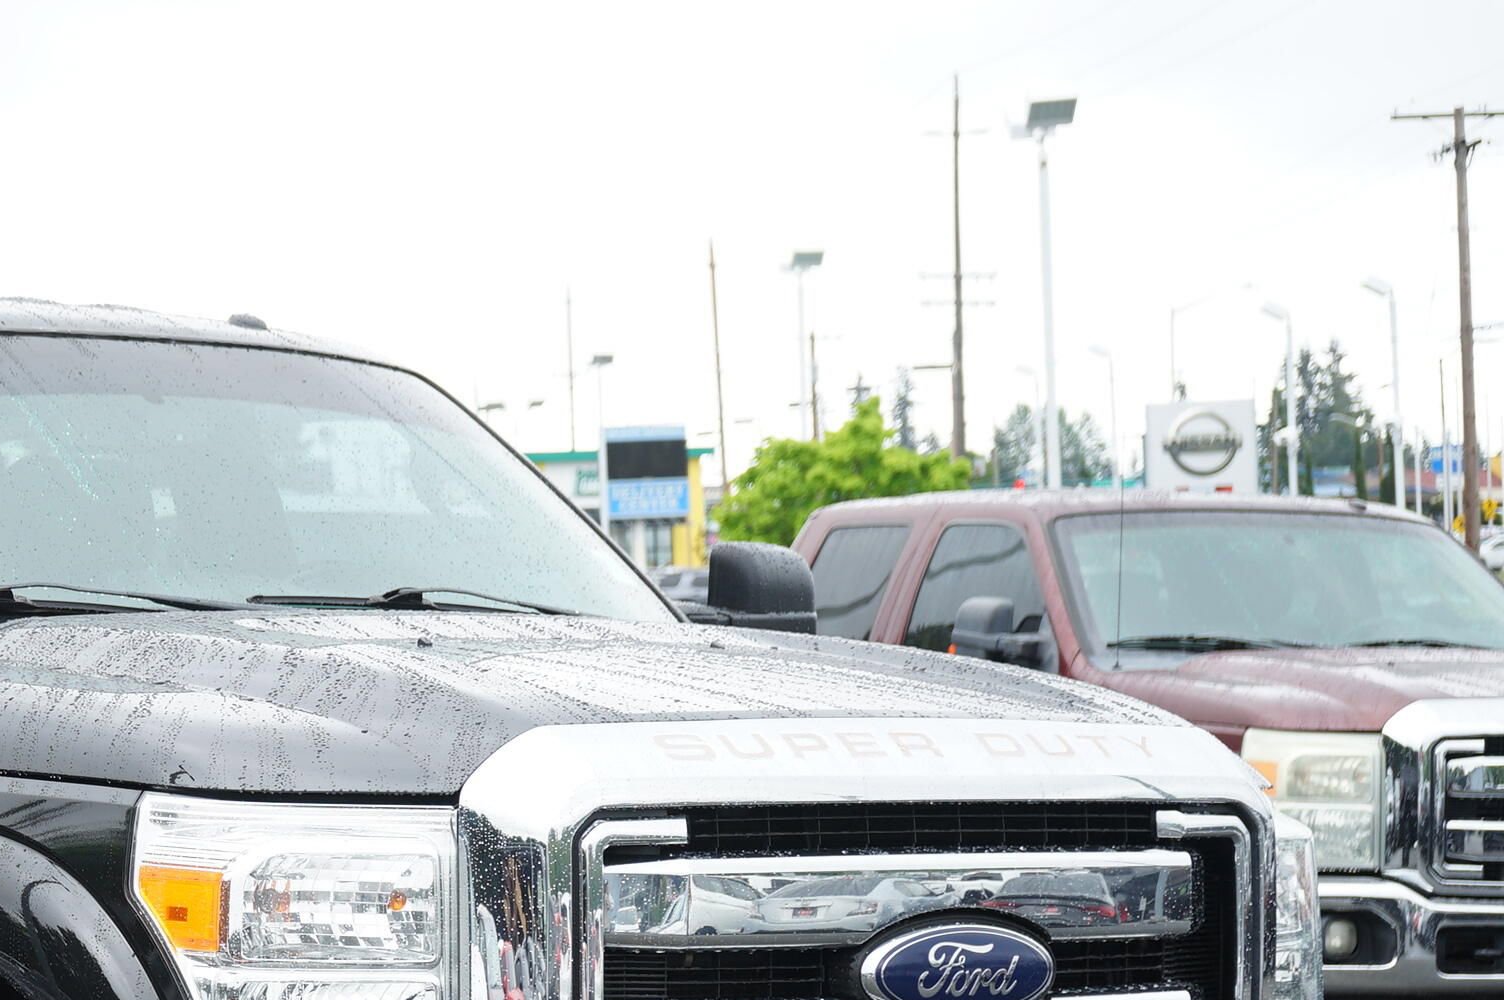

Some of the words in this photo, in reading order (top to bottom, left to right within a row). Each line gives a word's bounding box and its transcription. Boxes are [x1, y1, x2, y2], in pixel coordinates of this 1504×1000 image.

[653, 731, 945, 761] SUPER
[975, 731, 1154, 759] DUTY
[917, 941, 1020, 998] Ford
